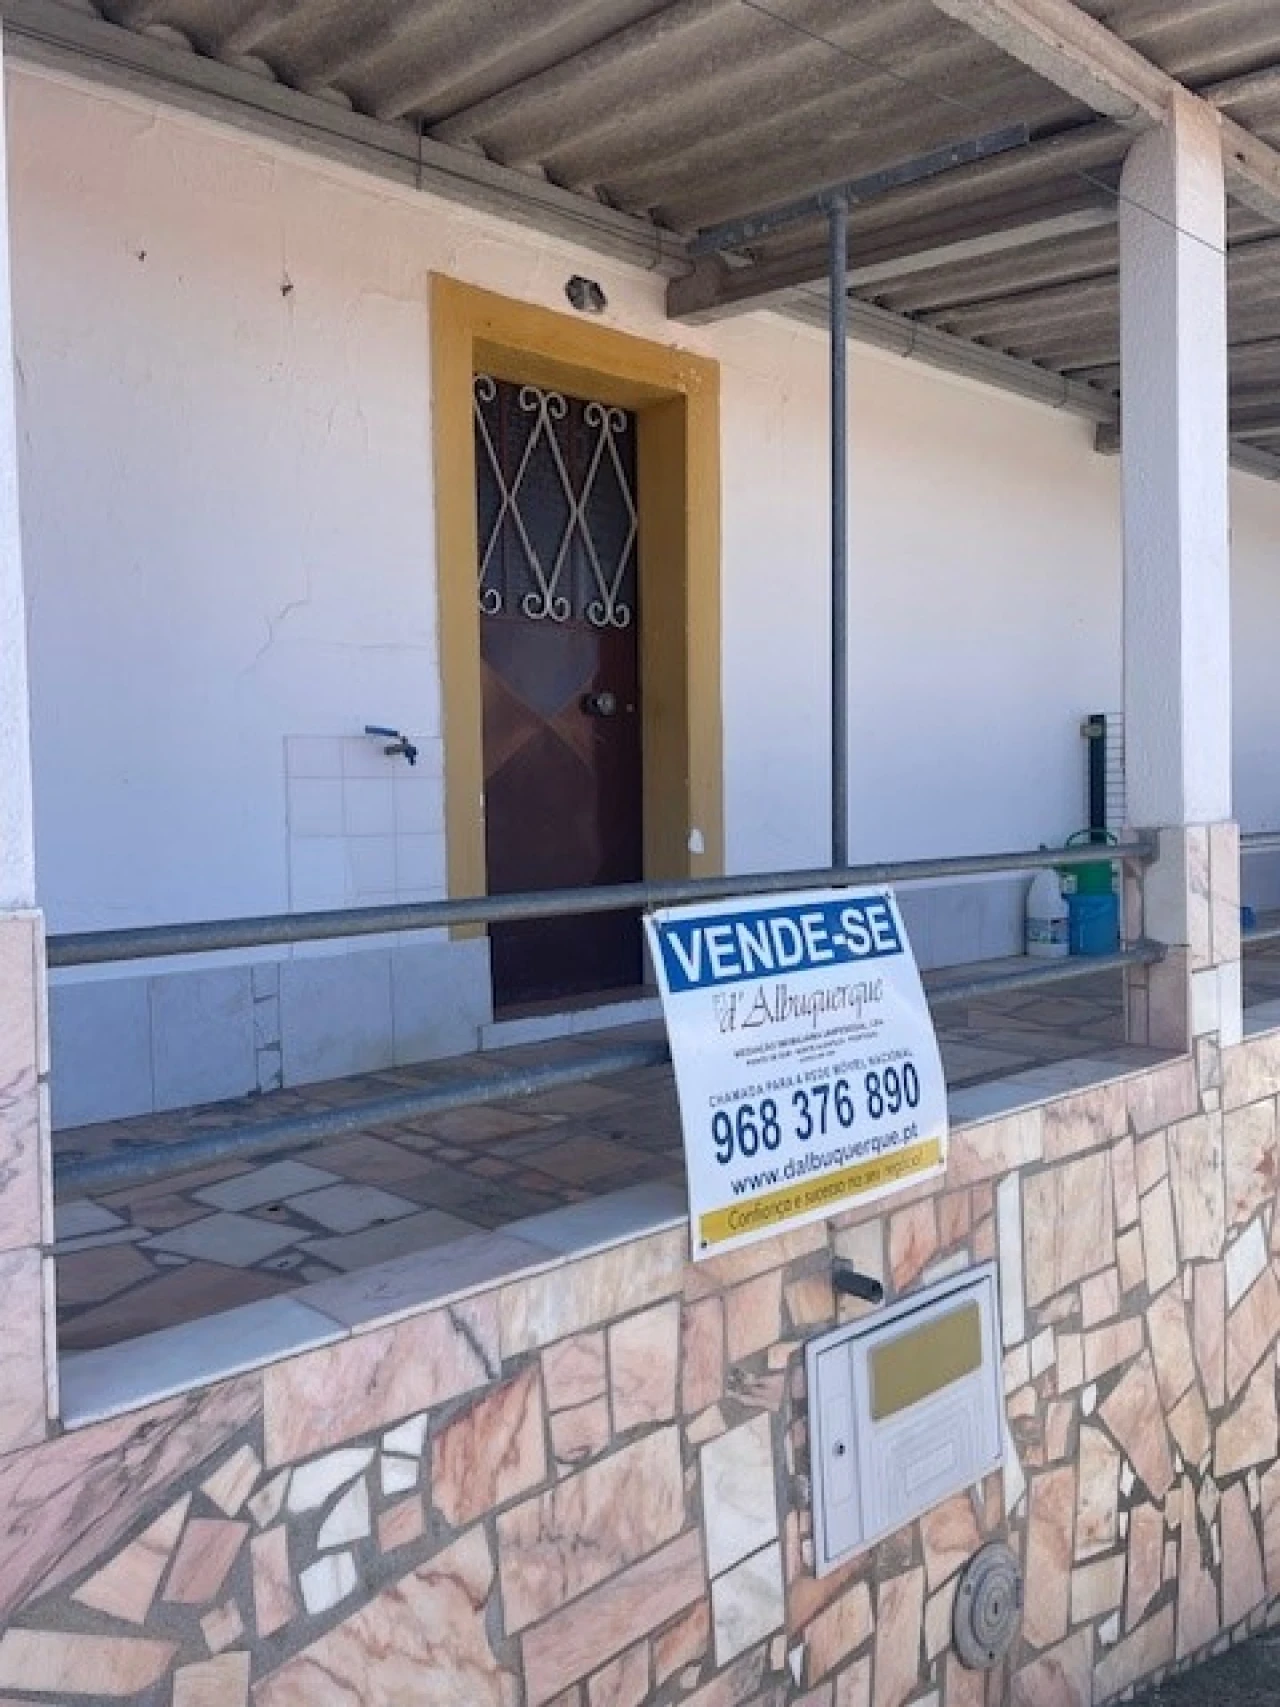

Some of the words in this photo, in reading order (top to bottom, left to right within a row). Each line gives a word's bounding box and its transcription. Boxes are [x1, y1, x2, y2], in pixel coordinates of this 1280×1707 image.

[666, 905, 897, 982] VENDE-SE
[711, 1099, 782, 1164] 968
[791, 1079, 855, 1140] 376
[864, 1061, 921, 1119] 890
[731, 1121, 918, 1195] www.dalbuquerque.pt
